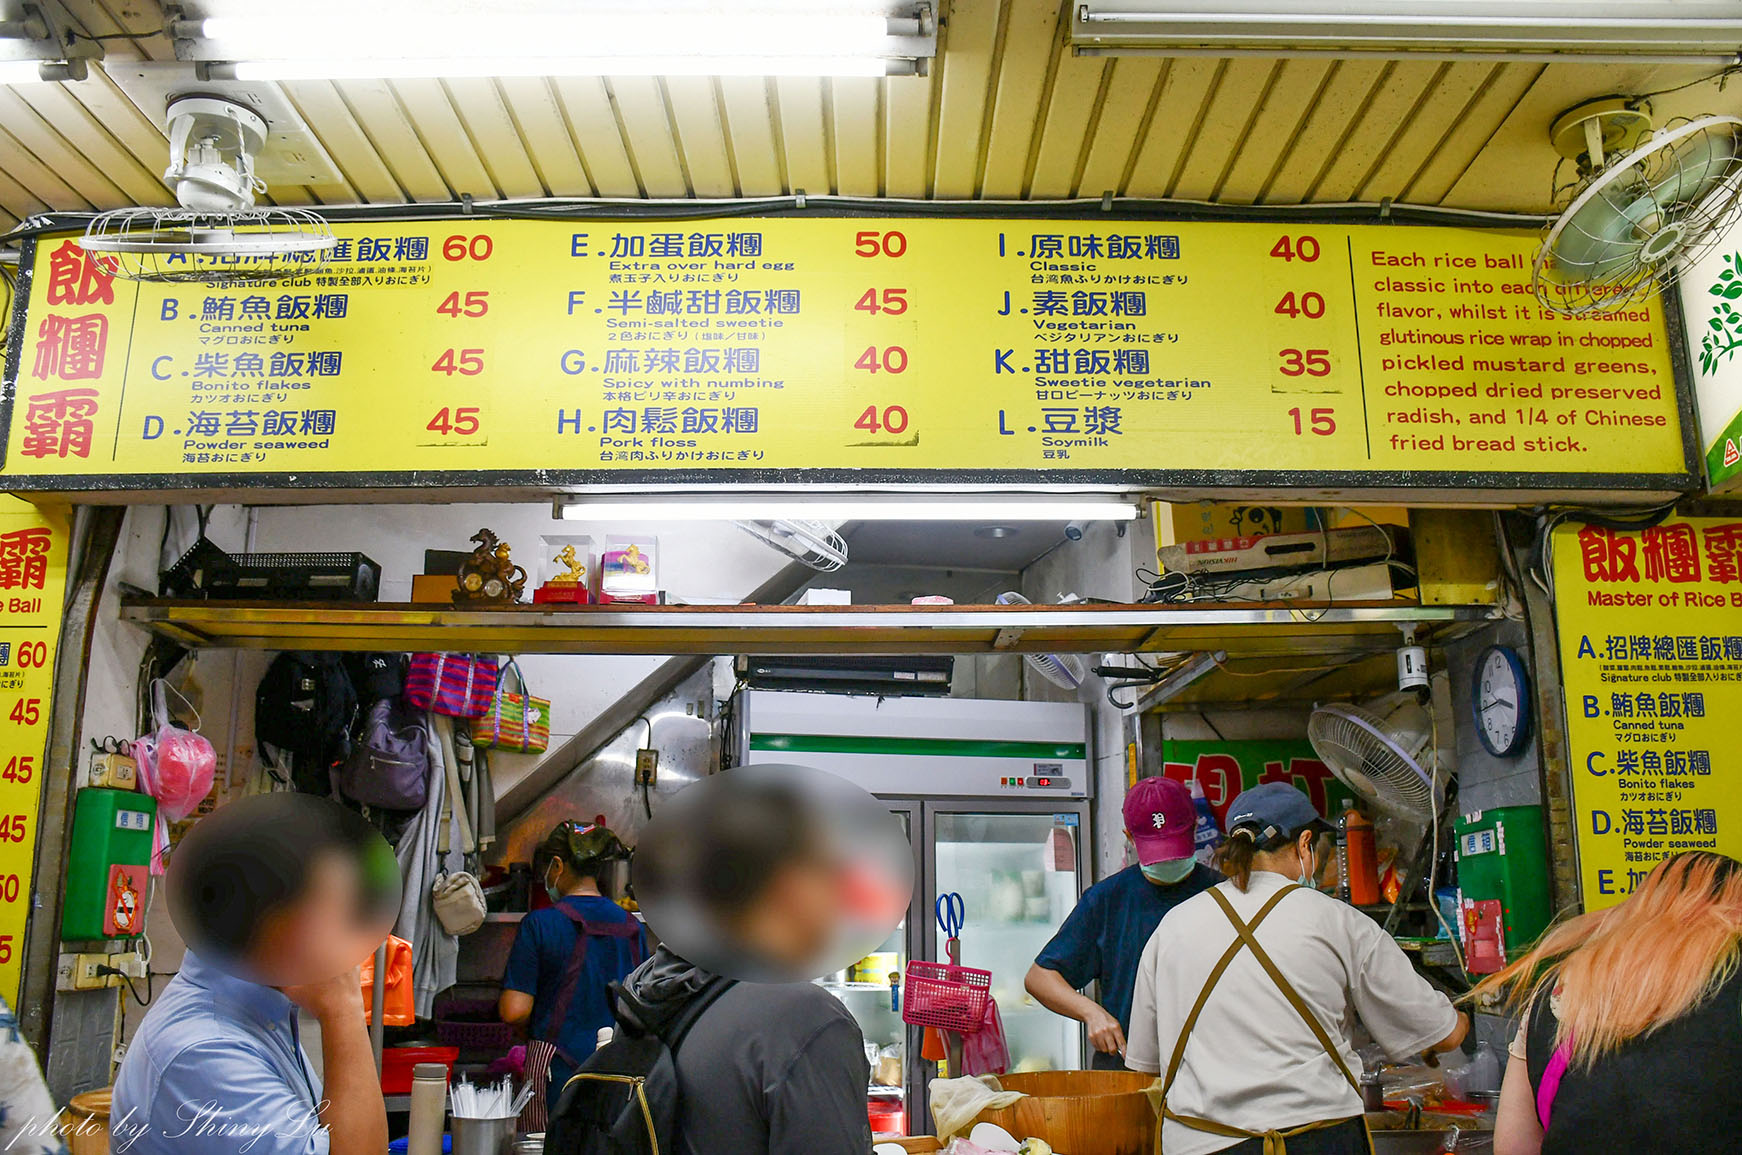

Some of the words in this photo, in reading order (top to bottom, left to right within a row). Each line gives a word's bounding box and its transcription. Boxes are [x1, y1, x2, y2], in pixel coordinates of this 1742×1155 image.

[442, 235, 493, 261] 60
[855, 231, 907, 258] 50
[1270, 236, 1320, 262] 40
[610, 261, 659, 271] Extra
[667, 262, 707, 271] over
[715, 260, 755, 271] hard
[762, 262, 794, 271] egg
[1030, 262, 1096, 271] Classic
[1372, 252, 1425, 267] Each
[1434, 253, 1476, 268] rice
[1485, 254, 1523, 269] ball
[282, 276, 311, 287] club
[316, 274, 430, 287] 特製全部入りおにぎり
[609, 273, 738, 283] 煮玉子入りおにぎり
[1374, 278, 1444, 292] classic
[1454, 279, 1493, 293] into
[1502, 280, 1547, 295] each
[1555, 279, 1645, 297] differe
[436, 292, 488, 318] 45
[854, 288, 907, 315] 45
[1275, 292, 1325, 318] 40
[1377, 304, 1441, 320] flavor,
[1450, 305, 1506, 320] whilst
[1516, 306, 1530, 320] it
[1539, 306, 1554, 320] is
[200, 323, 262, 334] Canned
[271, 323, 309, 332] tuna
[607, 318, 710, 329] Semi-salted
[716, 318, 783, 329] sweetie
[1034, 320, 1136, 331] Vegetarian
[199, 334, 294, 345] マグロおにぎり
[1034, 333, 1179, 343] ベジタリアンおにぎり
[1380, 329, 1464, 346] glutinous
[1470, 331, 1504, 345] rice
[1510, 334, 1551, 348] wrap
[1558, 333, 1574, 346] in
[1580, 332, 1652, 349] chopped
[432, 349, 484, 375] 45
[854, 346, 907, 374] 40
[1279, 349, 1331, 377] 35
[1383, 355, 1463, 372] pickled
[1473, 358, 1564, 372] mustard
[1574, 360, 1657, 375] greens,
[192, 380, 249, 391] Bonito
[256, 380, 311, 390] flakes
[603, 378, 654, 390] Spicy
[661, 378, 700, 388] with
[708, 378, 784, 391] numbing
[1035, 377, 1106, 387] Sweetie
[1113, 378, 1211, 389] vegetarian
[1385, 382, 1477, 399] chopped
[1486, 383, 1542, 398] dried
[1552, 385, 1661, 400] preserved
[190, 393, 287, 404] カツオおにぎり
[603, 391, 736, 401] 本格ピリ辛おにぎり
[427, 407, 479, 435] 45
[854, 405, 908, 434] 40
[1289, 407, 1336, 436] 15
[1388, 408, 1460, 425] radish,
[1469, 409, 1506, 424] and
[1516, 409, 1548, 425] 1/4
[1556, 410, 1576, 425] of
[1585, 410, 1666, 426] Chinese
[184, 439, 245, 450] Powder
[254, 439, 329, 449] seaweed
[600, 437, 642, 447] Pork
[651, 437, 696, 447] floss
[1042, 437, 1108, 448] Soymilk
[1390, 435, 1444, 450] fried
[1453, 436, 1514, 451] bread
[1524, 436, 1587, 452] stick.
[182, 452, 266, 463] 海苔おにぎり
[1042, 449, 1070, 459] 豆乳
[8, 597, 42, 614] Ball
[1588, 591, 1653, 607] Master
[1659, 592, 1680, 608] of
[1685, 593, 1726, 608] Rice
[17, 641, 47, 668] 60
[1600, 673, 1649, 683] Signature
[1652, 672, 1672, 682] club
[9, 699, 40, 726] 45
[1614, 721, 1655, 730] Canned
[1659, 722, 1684, 730] tuna
[1615, 733, 1676, 743] マグロおにぎり
[2, 756, 33, 784] 45
[1619, 779, 1655, 789] Bonito
[1660, 779, 1695, 789] flakes
[1620, 791, 1682, 802] カツオおにぎり
[0, 815, 27, 843] 45
[1624, 839, 1665, 849] Powder
[1669, 838, 1716, 849] seaweed
